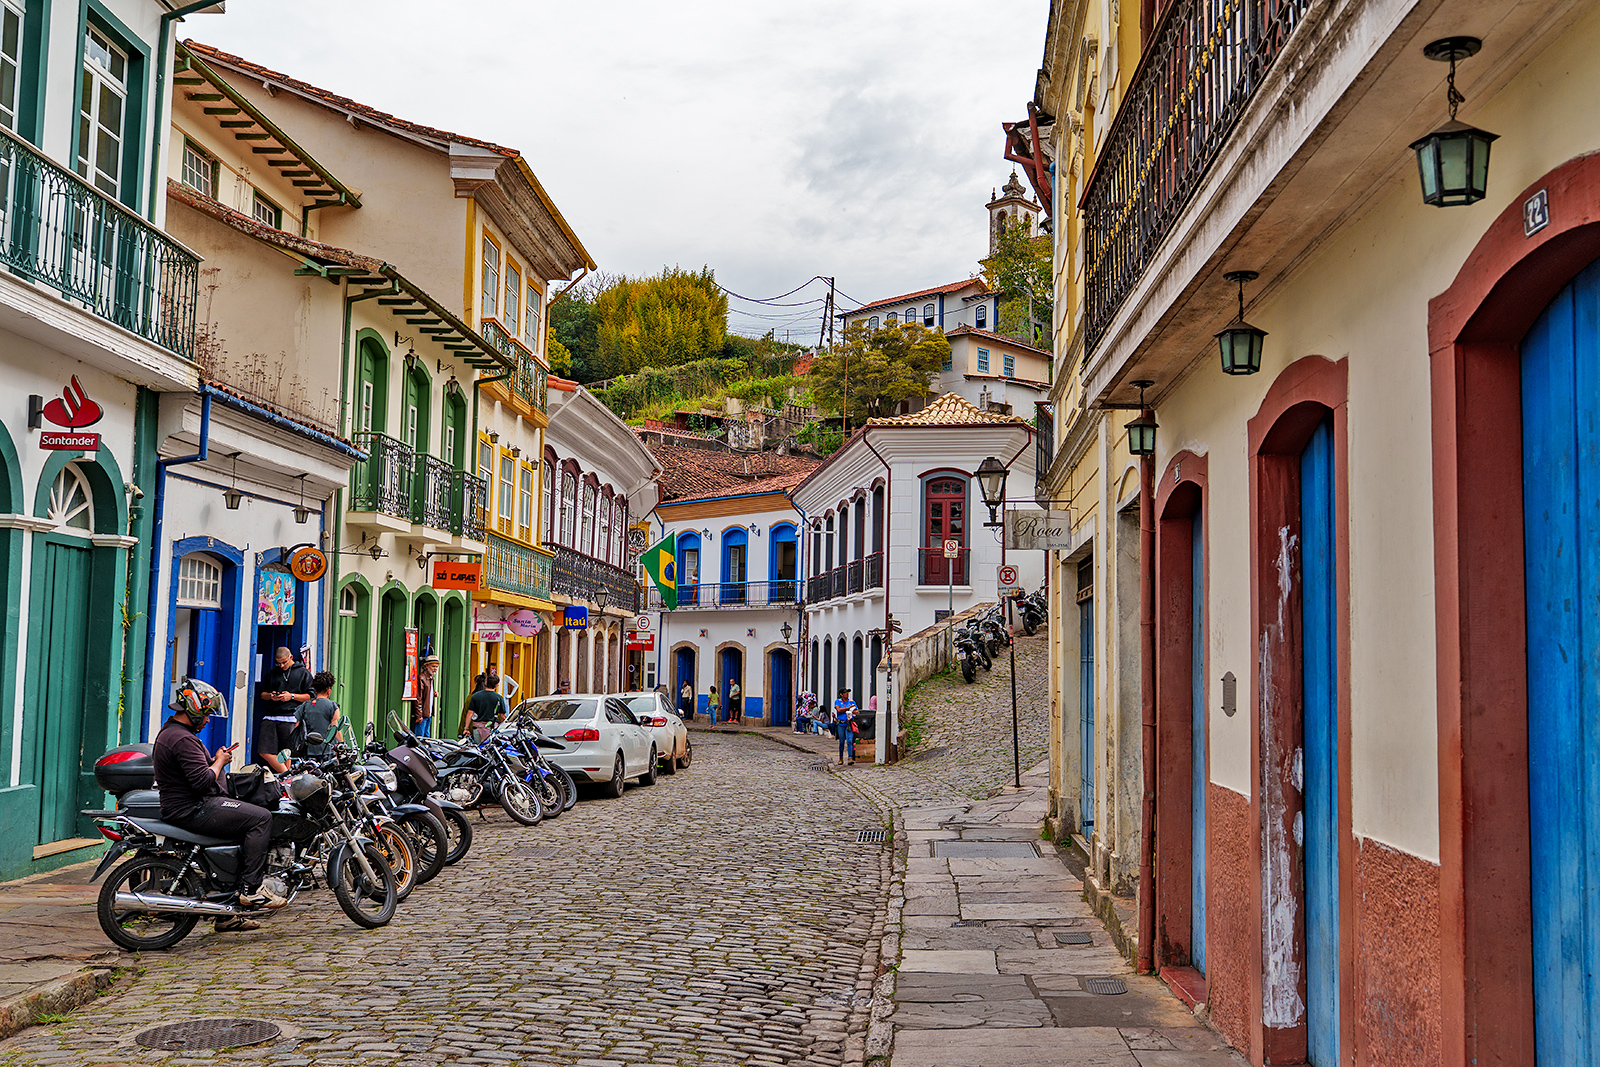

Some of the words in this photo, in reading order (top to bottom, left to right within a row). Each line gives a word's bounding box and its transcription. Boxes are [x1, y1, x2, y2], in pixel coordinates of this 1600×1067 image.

[1527, 198, 1543, 228] 72
[42, 435, 96, 446] Santander
[1013, 516, 1063, 538] Roca
[436, 570, 447, 580] SÓ
[450, 573, 476, 582] CAPAS
[565, 617, 586, 627] Itaú
[640, 618, 647, 627] E
